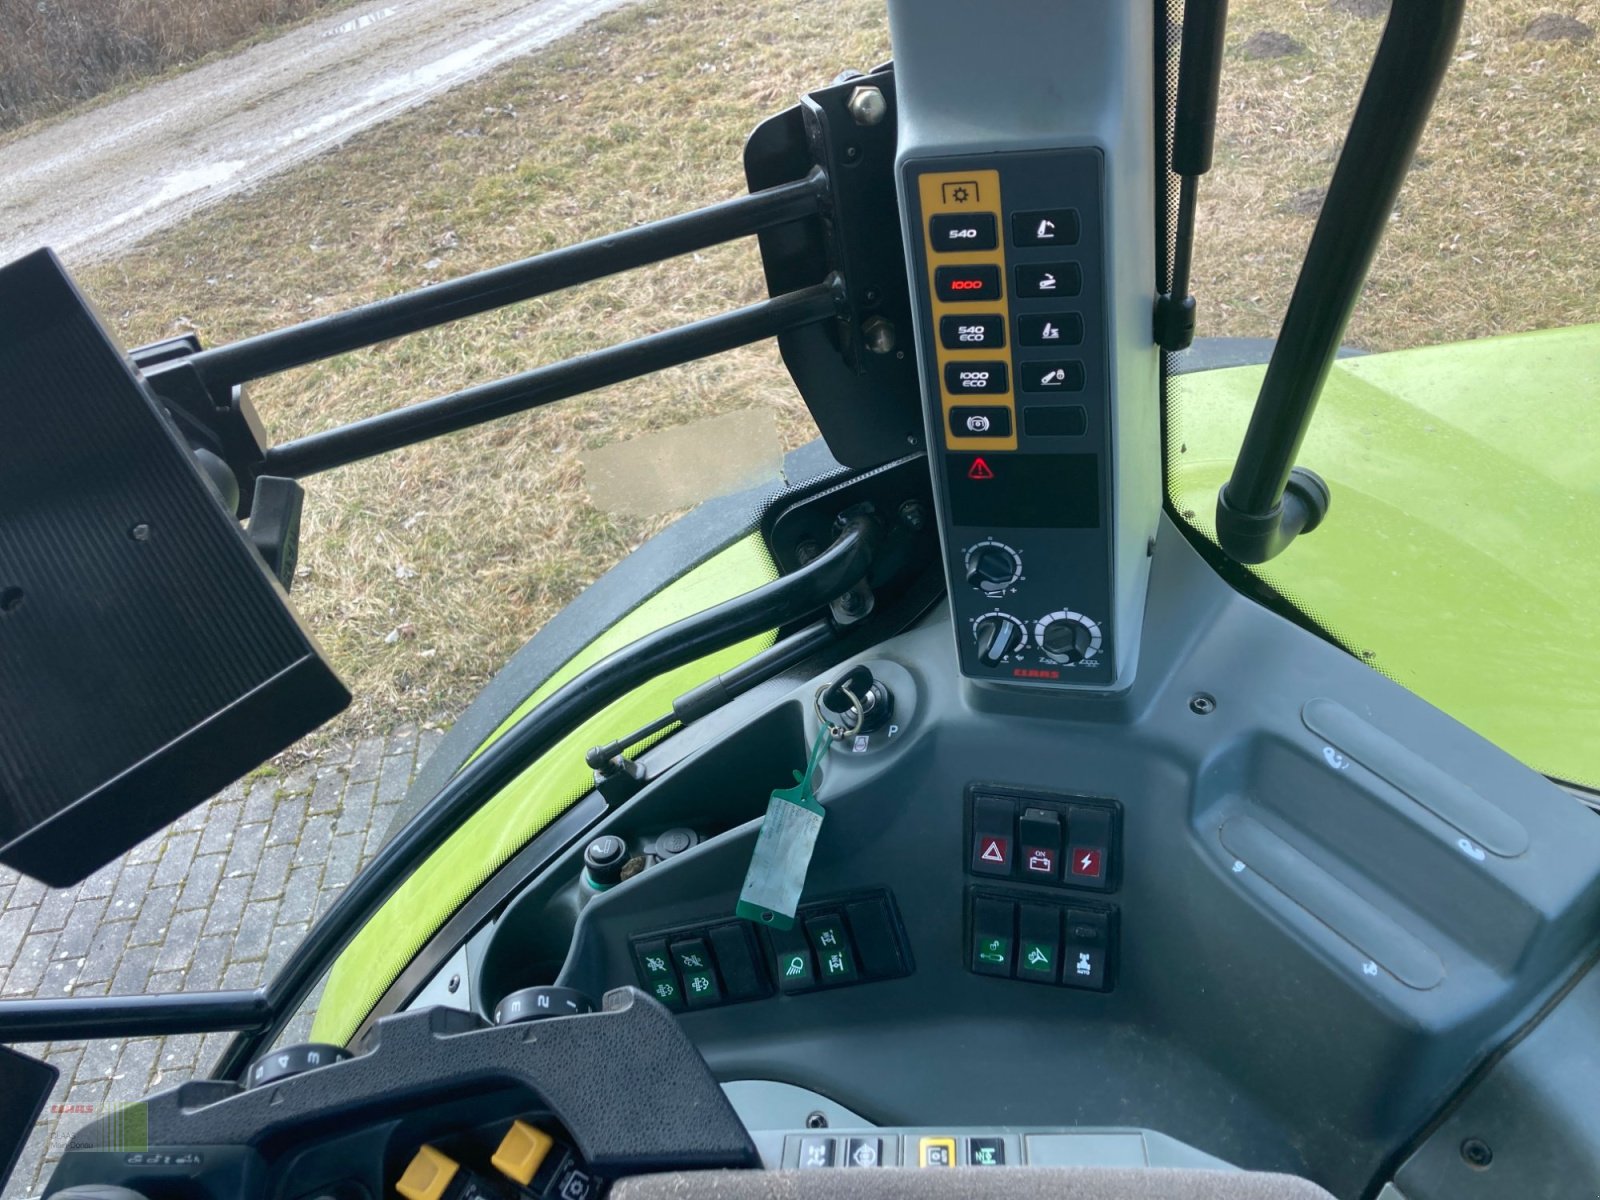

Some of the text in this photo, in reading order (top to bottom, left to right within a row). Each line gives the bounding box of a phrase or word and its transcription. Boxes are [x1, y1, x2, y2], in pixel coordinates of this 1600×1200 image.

[949, 230, 977, 238] 540
[952, 280, 982, 289] 1000
[958, 326, 984, 334] 540
[959, 334, 985, 342] ECO
[960, 372, 989, 380] 1000
[962, 380, 987, 388] ECO
[1013, 669, 1060, 679] CLAAS
[888, 725, 898, 737] P
[538, 995, 549, 1008] 2
[277, 1055, 290, 1069] 4
[307, 1050, 320, 1065] 3
